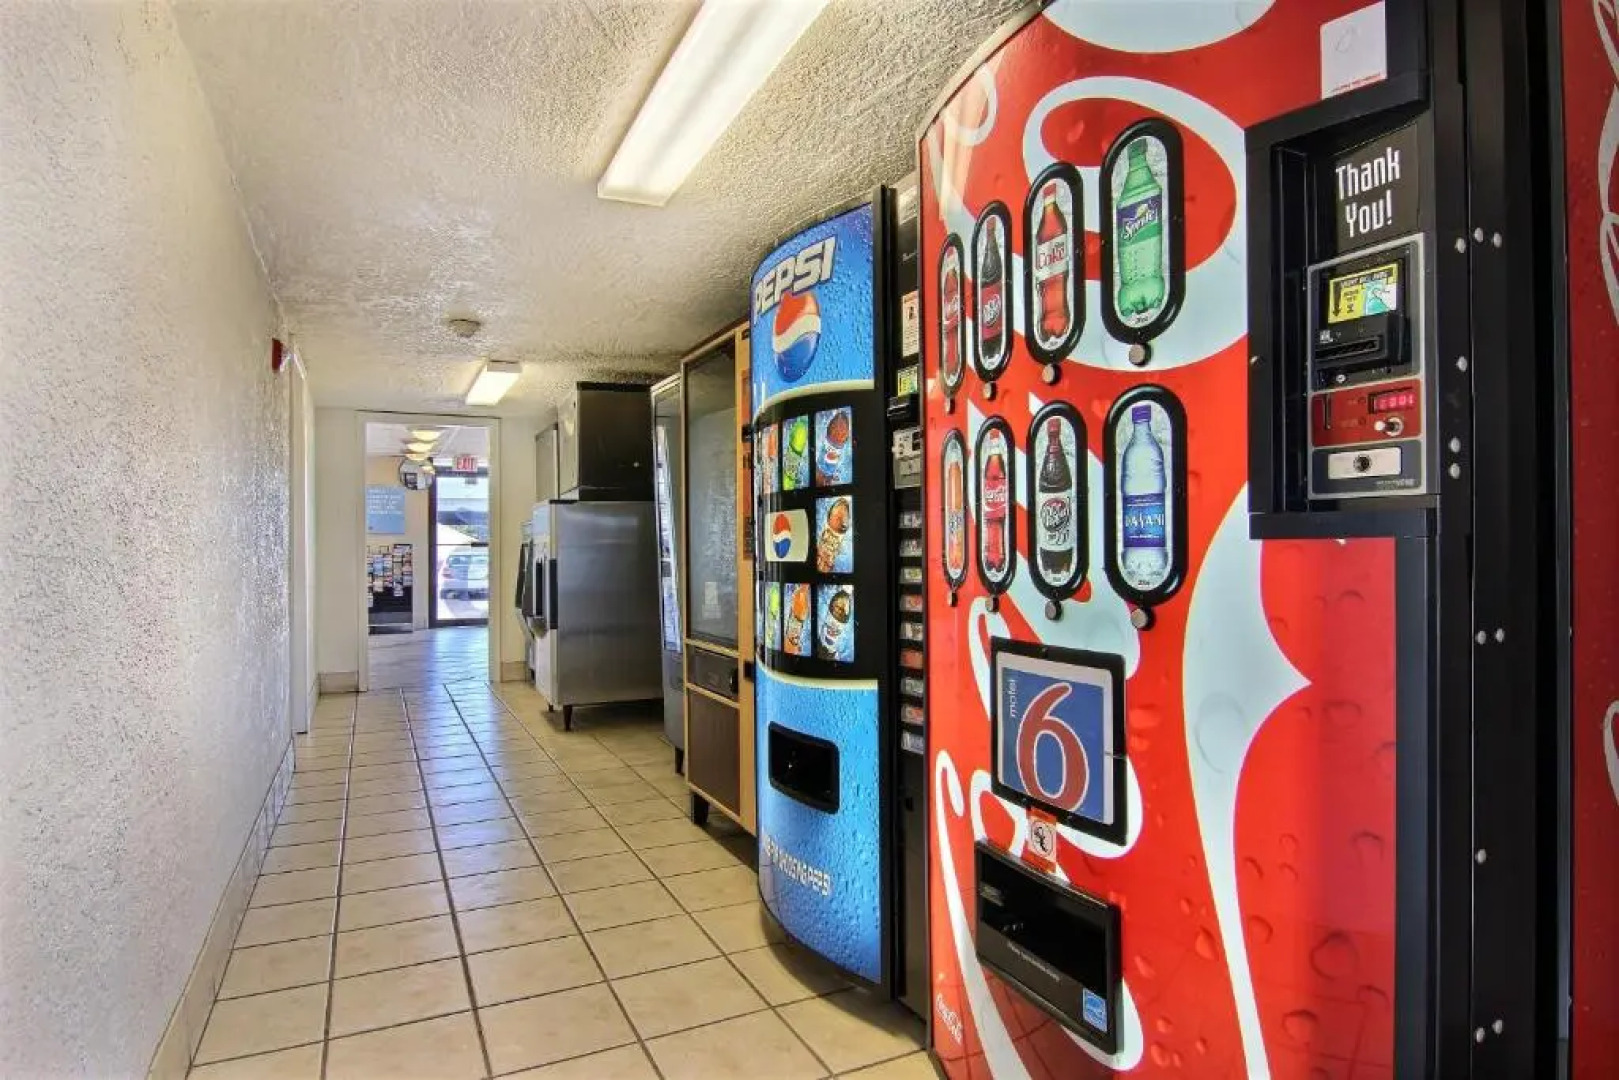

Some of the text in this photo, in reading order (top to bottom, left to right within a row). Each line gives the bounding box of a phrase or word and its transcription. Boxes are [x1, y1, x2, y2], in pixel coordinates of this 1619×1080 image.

[1335, 147, 1400, 199] Thank
[1345, 189, 1392, 237] You!
[754, 236, 836, 325] PEPSI
[456, 456, 475, 469] EXIT
[1016, 682, 1090, 812] 6
